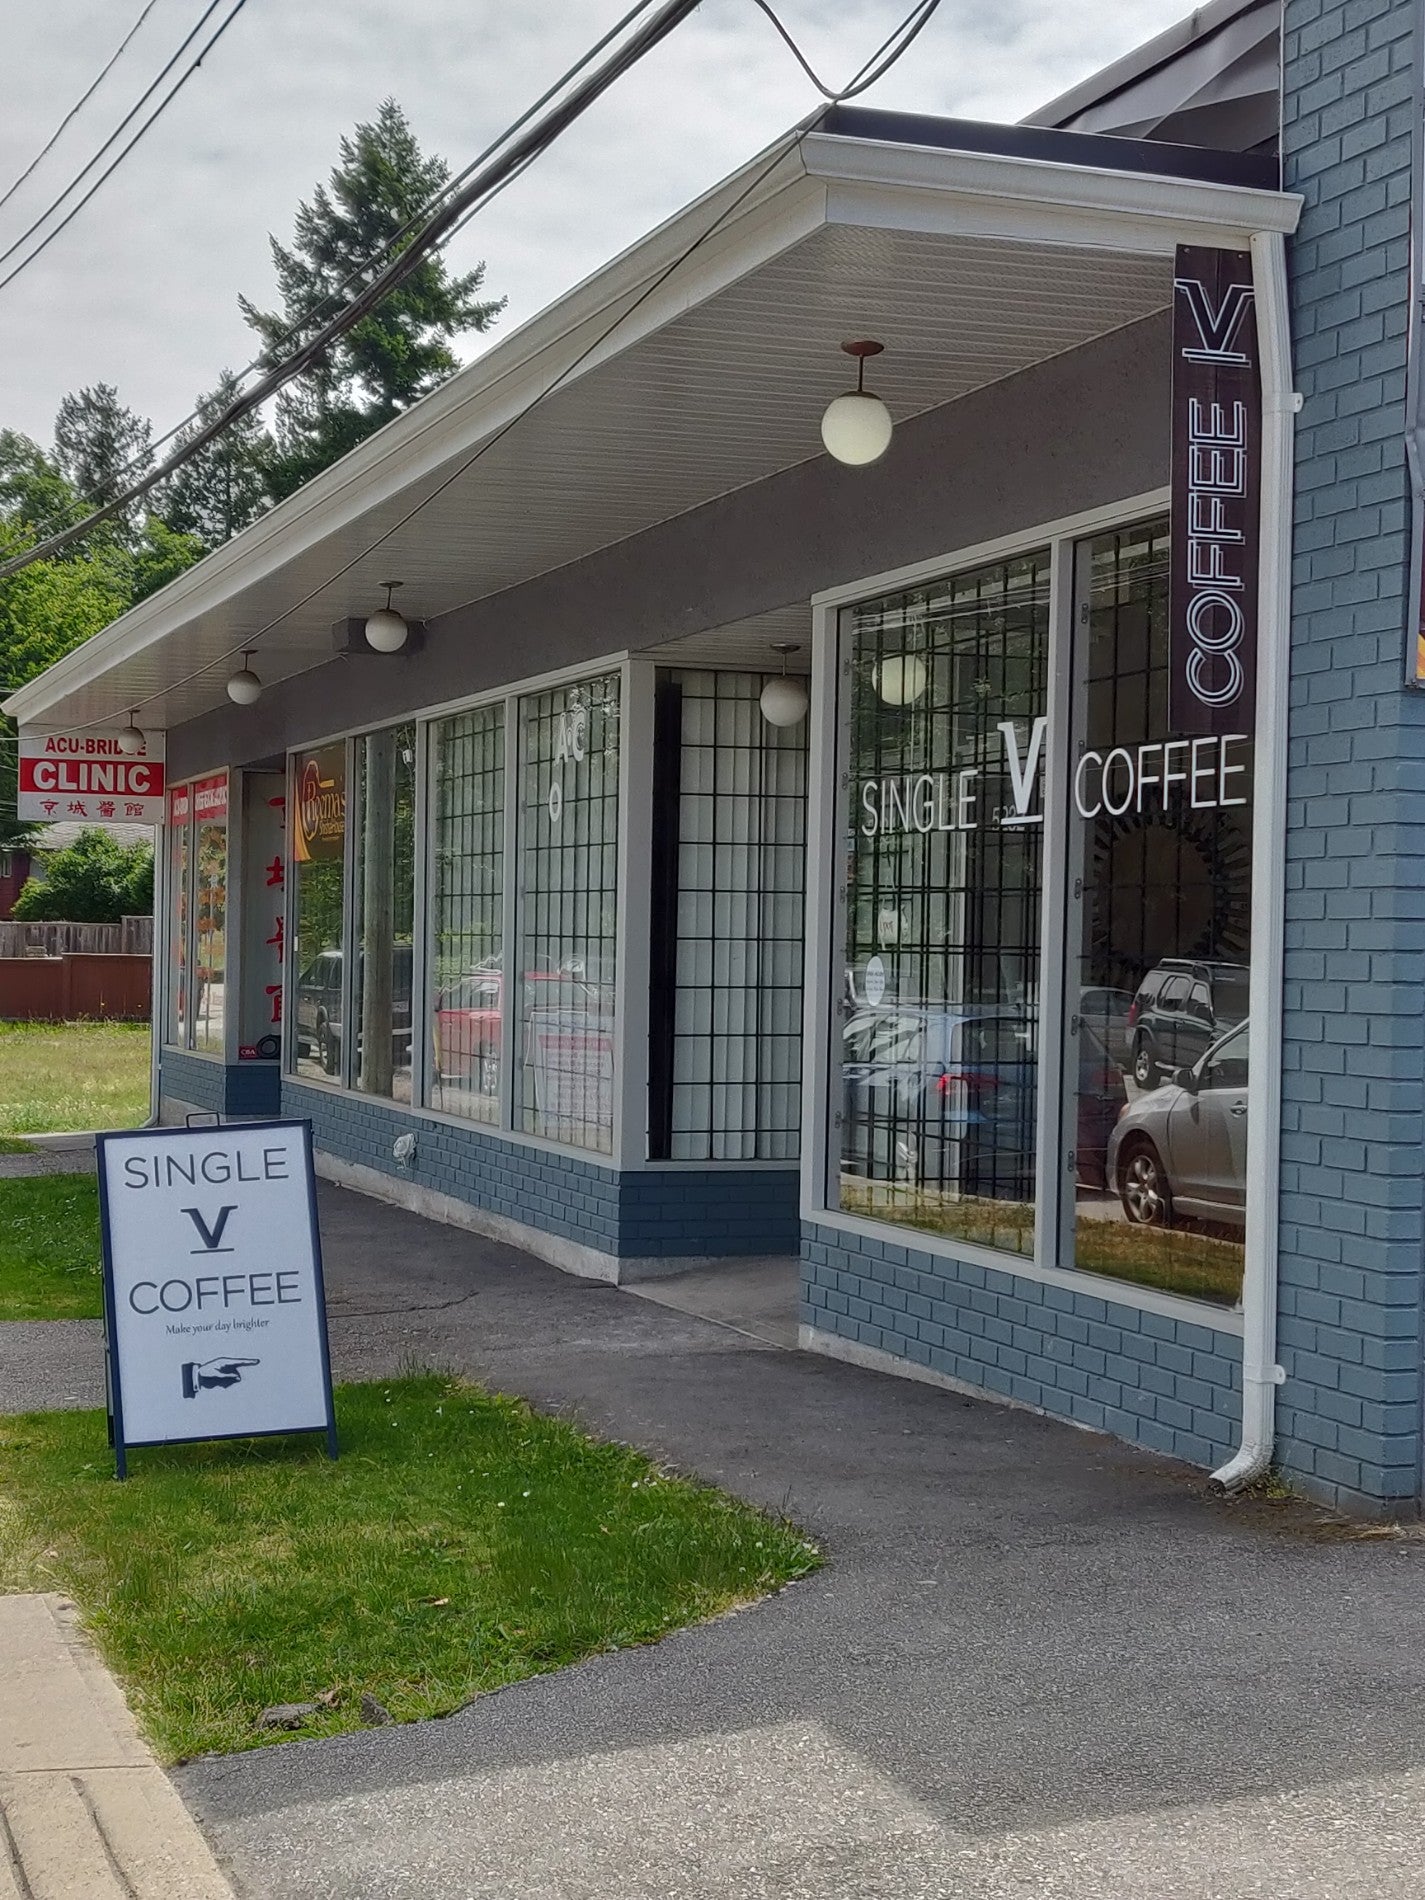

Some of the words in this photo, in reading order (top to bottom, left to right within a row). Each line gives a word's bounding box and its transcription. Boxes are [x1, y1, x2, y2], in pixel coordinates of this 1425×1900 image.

[1174, 278, 1255, 367] V
[1186, 397, 1247, 707] COFFEE
[45, 737, 147, 756] ACU-BRIDE
[33, 761, 150, 793] CLINIC
[861, 769, 978, 837] SINGLE
[997, 716, 1048, 825] V
[1075, 734, 1248, 818] COFFEE
[124, 1147, 289, 1189] SINGLE
[180, 1205, 239, 1255] V
[129, 1270, 302, 1315] COFFEE
[165, 1322, 191, 1335] Make
[192, 1324, 213, 1336] your
[214, 1319, 231, 1333] day
[232, 1317, 270, 1332] brighter
